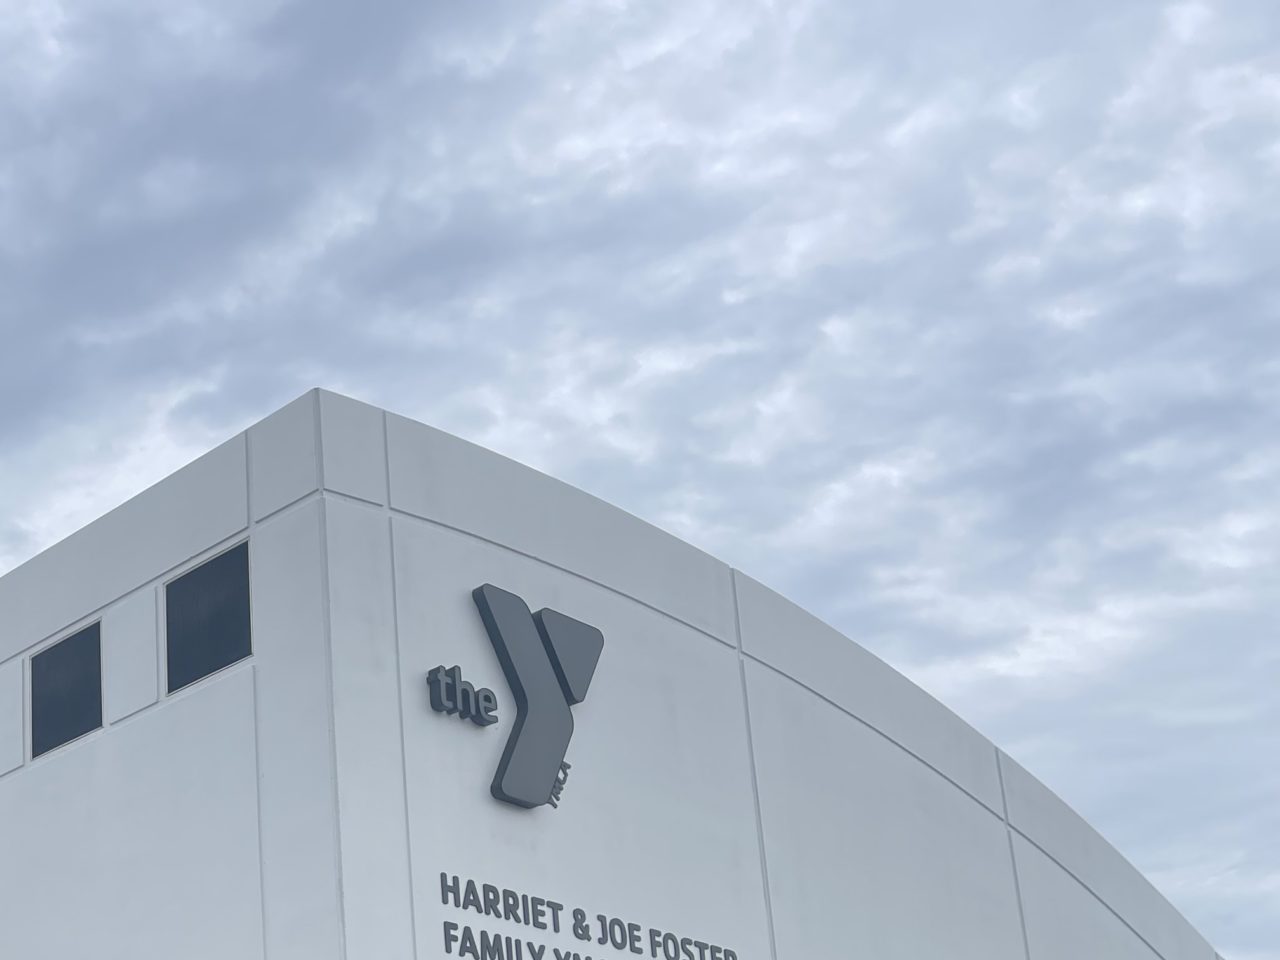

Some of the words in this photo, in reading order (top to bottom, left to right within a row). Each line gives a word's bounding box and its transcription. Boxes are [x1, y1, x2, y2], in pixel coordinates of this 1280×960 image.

[427, 665, 498, 726] the
[440, 872, 563, 933] HARRIET
[572, 908, 592, 942] &
[597, 914, 643, 955] JOE
